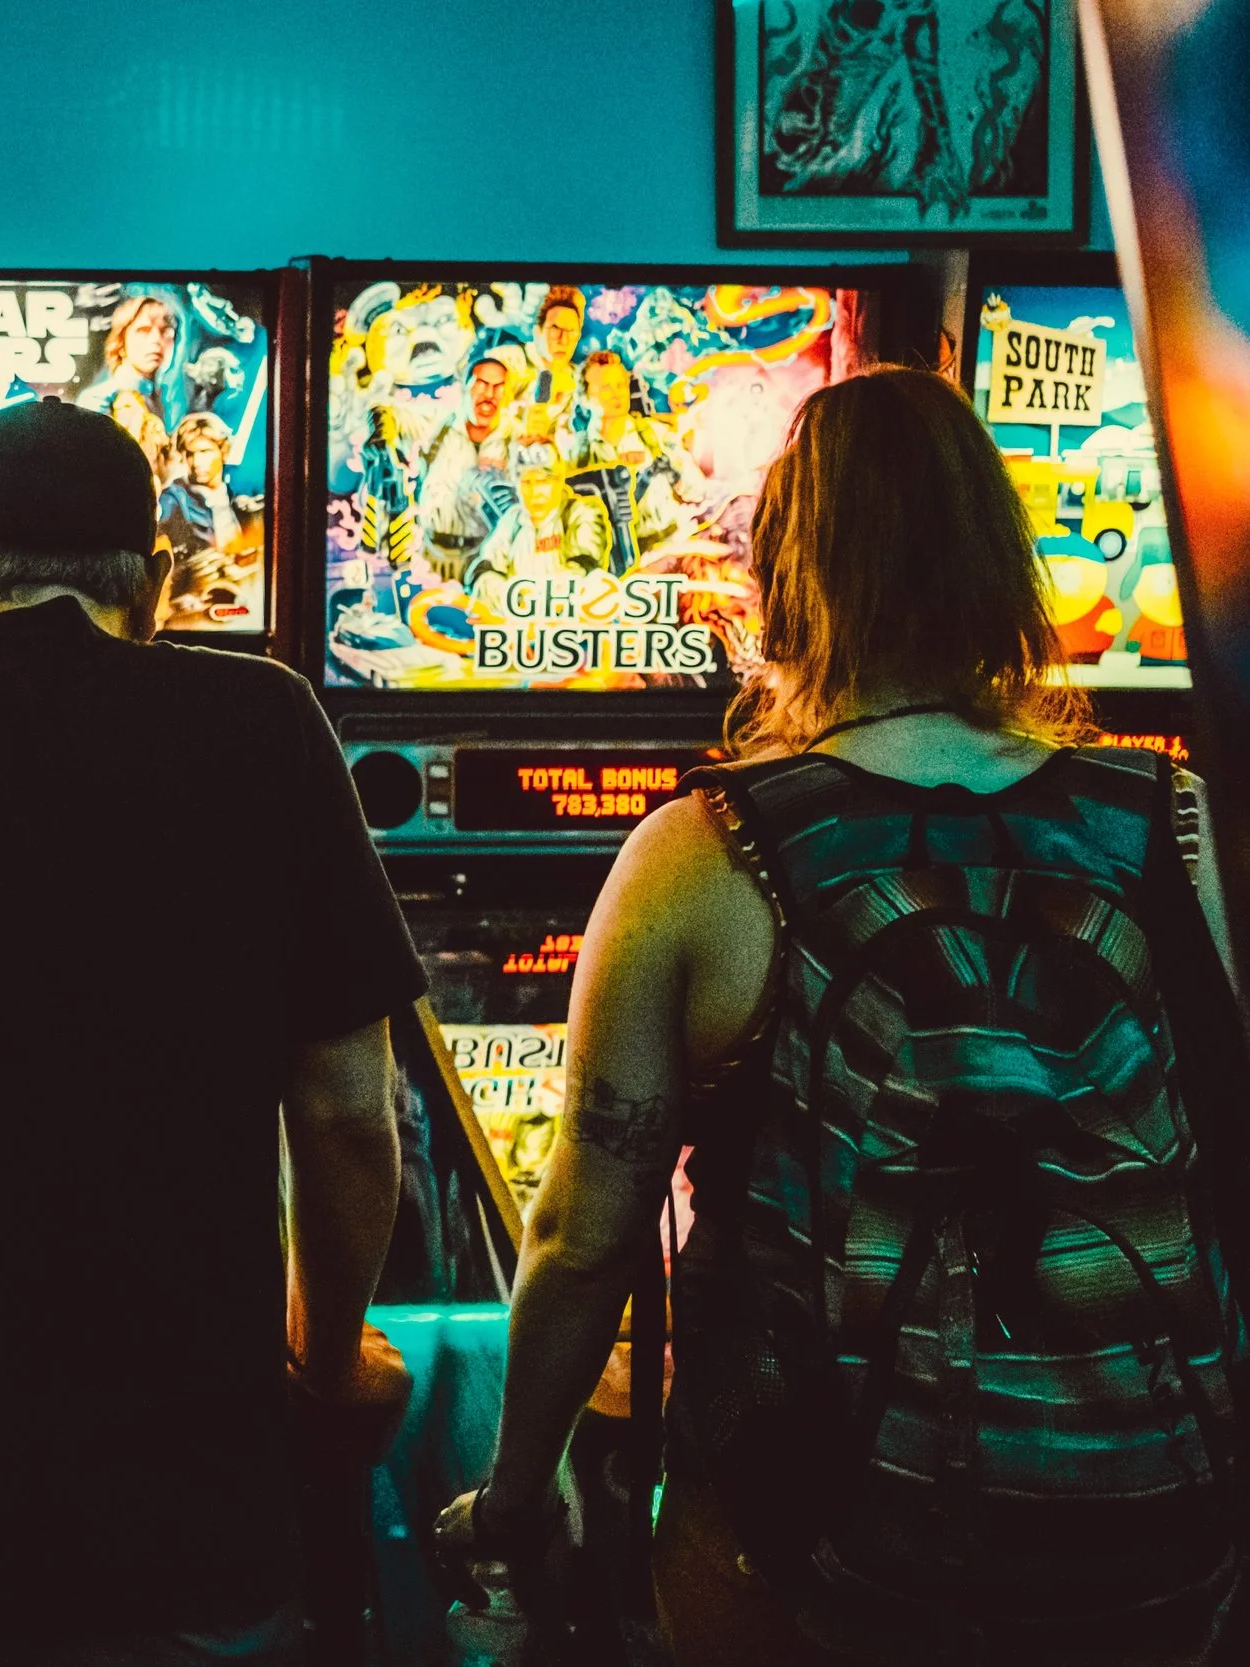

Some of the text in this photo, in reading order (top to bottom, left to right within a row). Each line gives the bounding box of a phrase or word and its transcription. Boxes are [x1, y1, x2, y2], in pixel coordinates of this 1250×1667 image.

[1006, 331, 1096, 377] SOUTH
[1002, 374, 1092, 411] PARK
[477, 628, 712, 669] BUSTERS
[517, 768, 678, 790] TOTAL BONUS
[551, 793, 647, 818] 783,380
